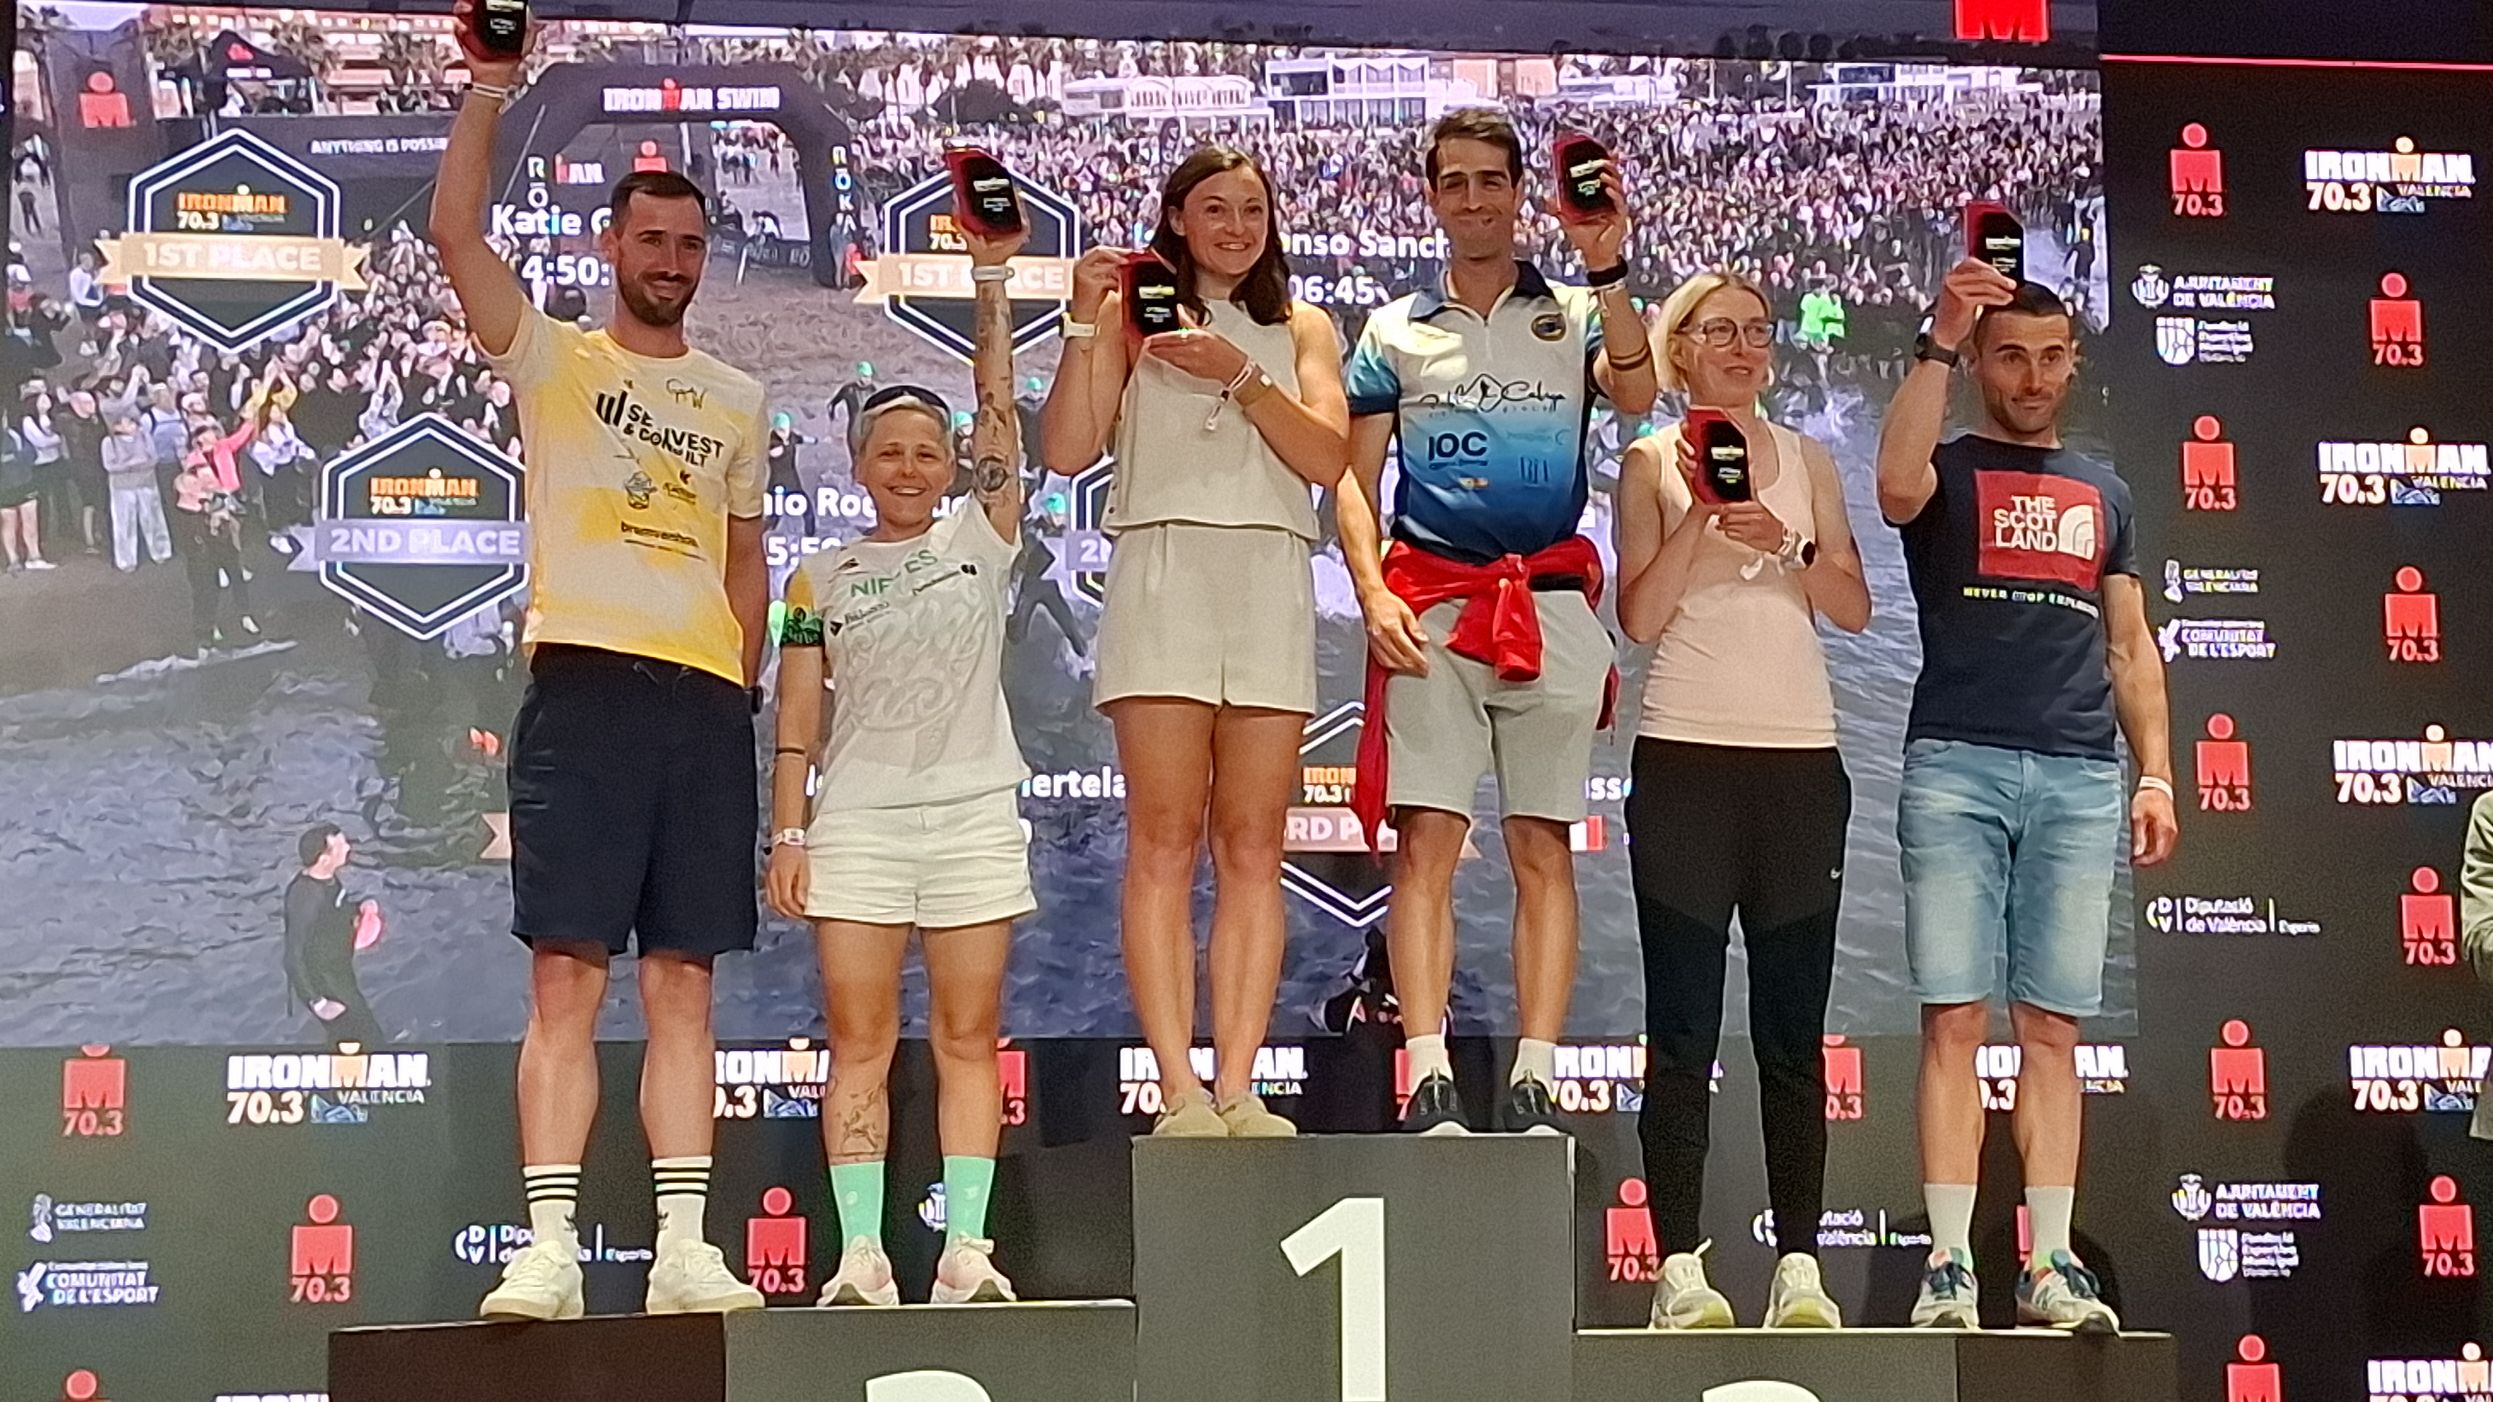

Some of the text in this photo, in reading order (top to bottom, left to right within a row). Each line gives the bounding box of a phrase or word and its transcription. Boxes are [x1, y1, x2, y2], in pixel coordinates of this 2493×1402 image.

[603, 87, 780, 112] IRONMAN SWIM
[2305, 150, 2472, 183] IRONMAN
[177, 193, 287, 214] IRONMAN
[2173, 194, 2224, 216] 70.3
[2306, 182, 2372, 211] 70.3
[178, 212, 220, 230] 70.3
[491, 205, 582, 235] Katie
[143, 244, 322, 271] 1ST PLACE
[899, 264, 952, 286] 1ST
[2373, 344, 2424, 366] 70.3
[2318, 442, 2487, 474] IRONMAN
[371, 477, 476, 497] IRONMAN
[2185, 487, 2237, 510] 70.3
[2319, 474, 2487, 504] 70.3 VALENCIA
[371, 497, 412, 515] 70.3
[2011, 495, 2056, 514] THE
[1994, 508, 2057, 531] SCOT
[330, 528, 521, 554] 2ND PLACE
[1995, 528, 2058, 552] LAND
[2387, 639, 2439, 662] 70.3
[2333, 740, 2493, 772] IRONMAN
[1303, 767, 1357, 785] IRON
[2335, 773, 2402, 803] 70.3
[1303, 785, 1343, 804] 70.3
[2199, 788, 2250, 810] 70.3
[1287, 816, 1333, 840] RD
[2403, 942, 2456, 965] 70.3
[226, 1053, 428, 1089] IRONMAN
[226, 1090, 425, 1124] 70.3 VALENCIA
[2213, 1095, 2266, 1119] 70.3
[2352, 1081, 2420, 1111] 70.3
[63, 1111, 123, 1136] 70.3
[2422, 1253, 2475, 1277] 70.3
[46, 1272, 147, 1289] COMUNITAT
[291, 1277, 352, 1303] 70.3
[749, 1268, 806, 1293] 70.3
[52, 1288, 77, 1305] DE
[1280, 1197, 1387, 1402] 1
[2367, 1360, 2493, 1394] IRONM
